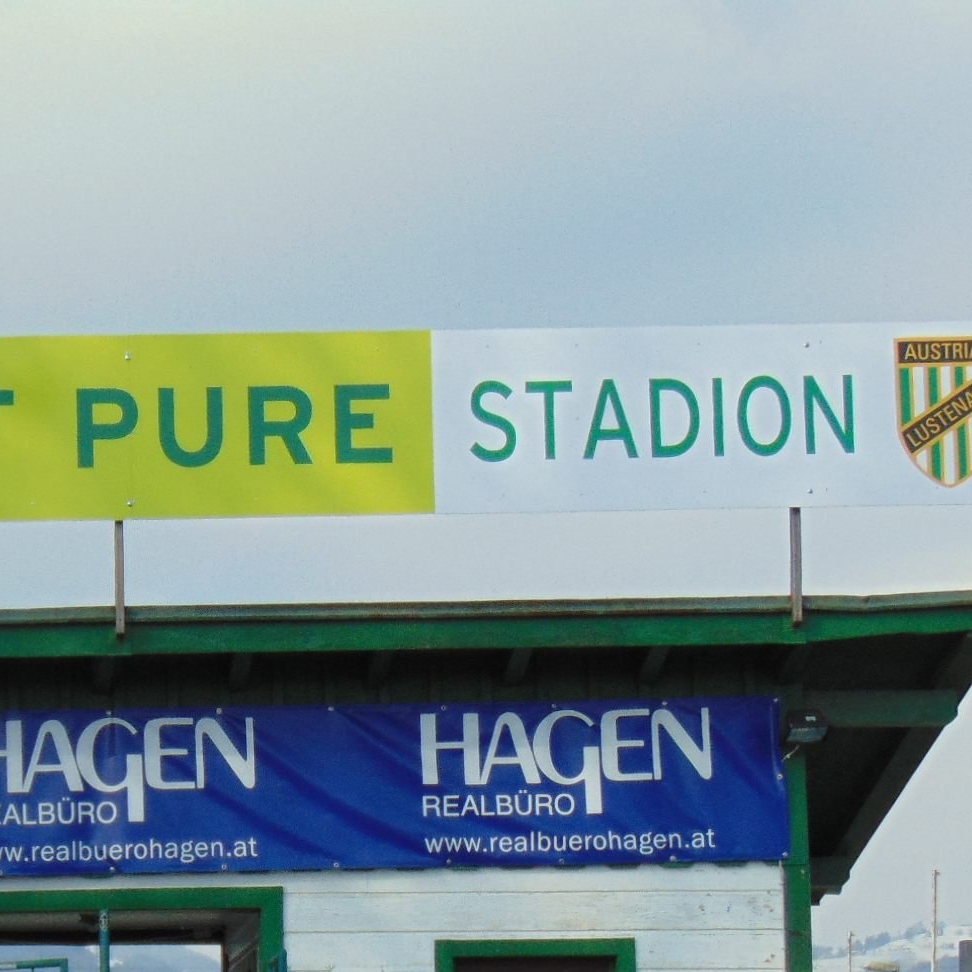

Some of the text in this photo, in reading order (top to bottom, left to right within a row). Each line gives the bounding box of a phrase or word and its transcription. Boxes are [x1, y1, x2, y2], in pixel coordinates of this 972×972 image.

[904, 342, 972, 361] AUSTRI
[76, 383, 393, 469] PURE
[470, 374, 856, 463] STADION
[420, 707, 713, 815] HAGEN
[422, 789, 575, 817] REALBÜRO
[425, 828, 716, 854] www.realbuerohagen.at
